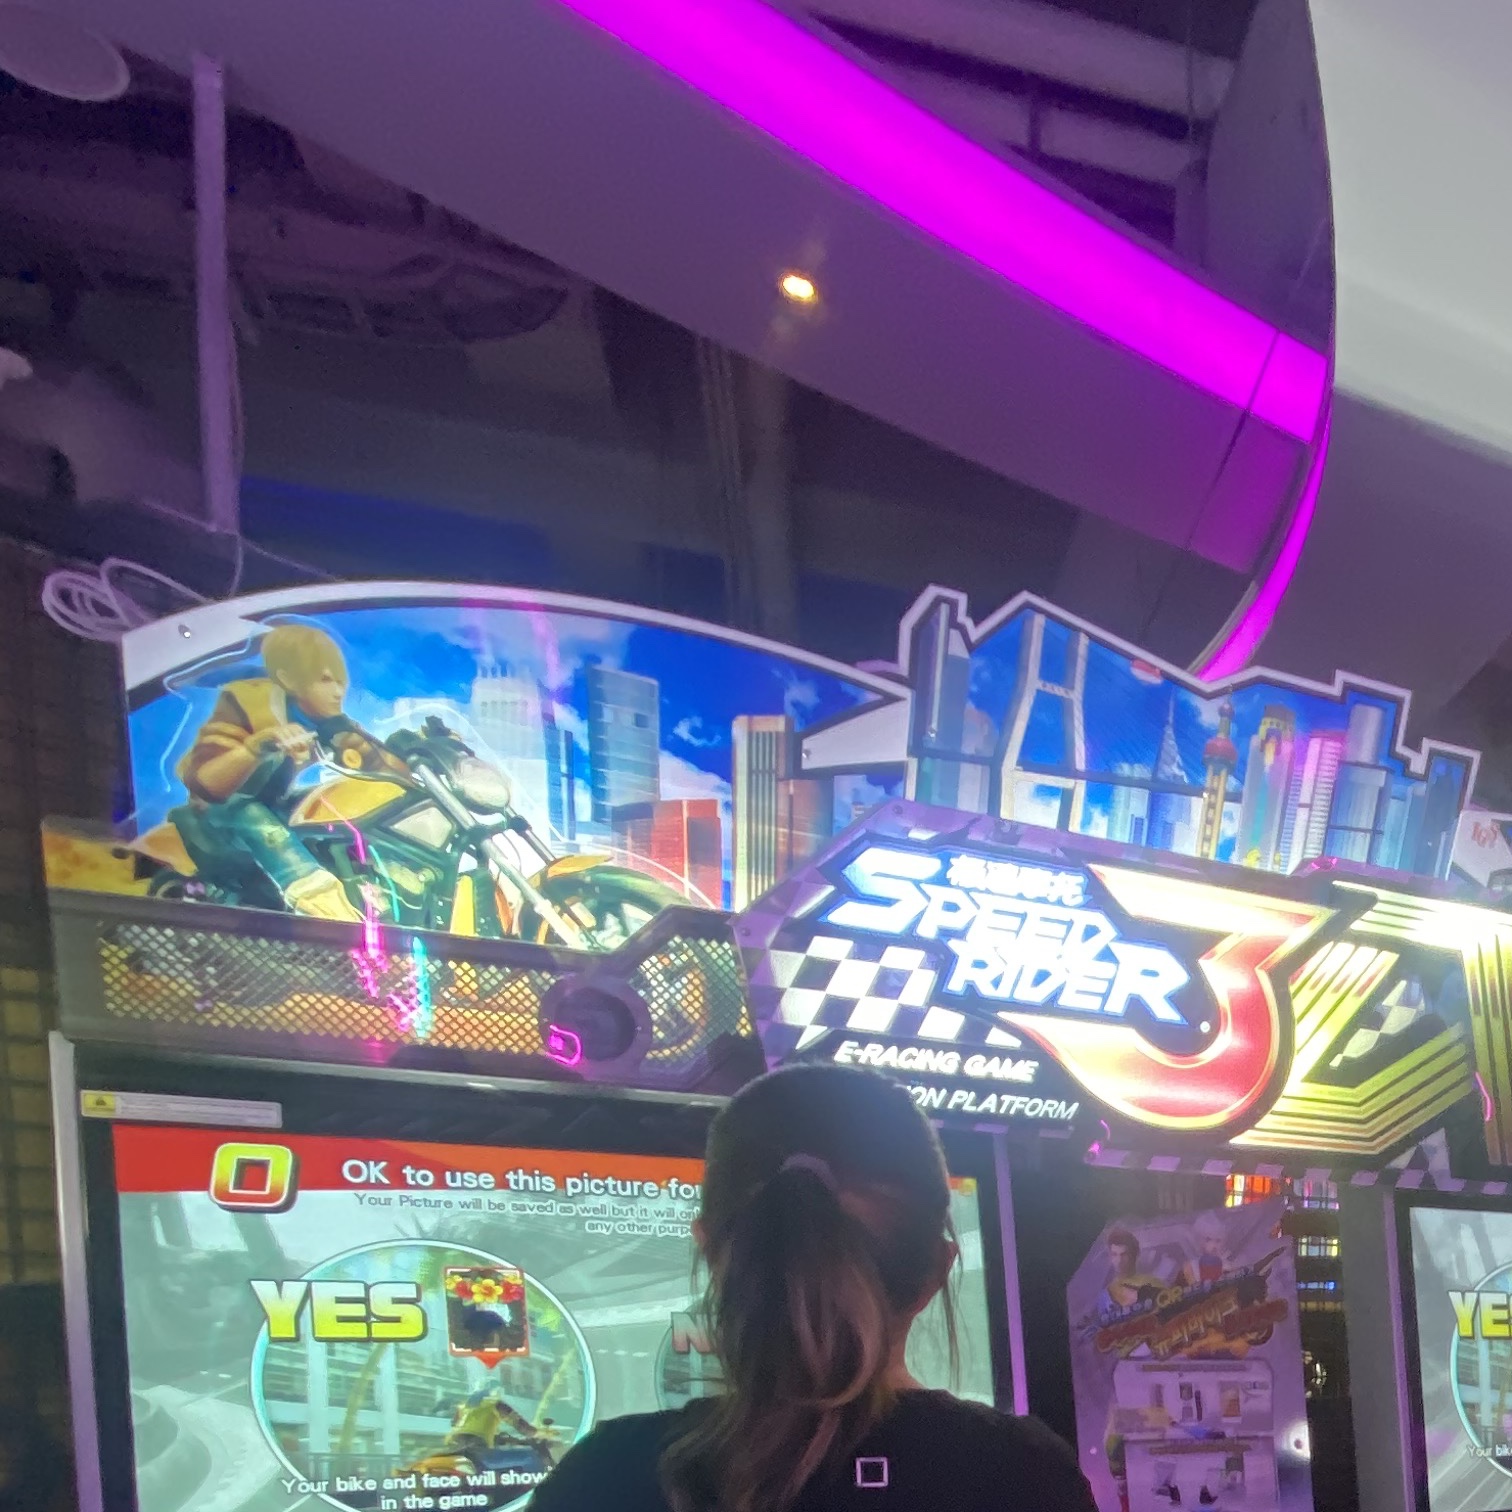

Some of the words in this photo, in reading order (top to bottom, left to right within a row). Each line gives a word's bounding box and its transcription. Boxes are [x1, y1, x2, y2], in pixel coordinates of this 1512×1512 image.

[824, 846, 1118, 958] SPEED
[946, 942, 1190, 1024] RIDER
[834, 1041, 957, 1077] E-RACING
[961, 1055, 1039, 1083] GAME
[948, 1089, 1079, 1121] PLATFORM
[342, 1159, 390, 1185] OK
[402, 1163, 435, 1188] to
[445, 1170, 495, 1190] use
[505, 1167, 556, 1193] this
[565, 1173, 660, 1199] picture
[354, 1192, 392, 1208] Your
[399, 1193, 453, 1210] Picture
[458, 1196, 483, 1210] will
[487, 1199, 506, 1212] be
[511, 1200, 554, 1215] saved
[559, 1203, 575, 1215] as
[579, 1203, 607, 1216] well
[611, 1204, 634, 1218] but
[639, 1205, 649, 1218] it
[653, 1206, 676, 1219] will
[586, 1219, 613, 1235] any
[617, 1218, 652, 1234] other
[658, 1222, 693, 1238] purp
[251, 1280, 428, 1343] YES
[670, 1311, 715, 1355] N
[1468, 1445, 1493, 1458] Your
[282, 1477, 329, 1496] Your
[336, 1475, 378, 1493] bike
[382, 1472, 417, 1490] and
[422, 1471, 461, 1489] face
[466, 1470, 497, 1488] will
[501, 1468, 549, 1486] show
[381, 1493, 398, 1511] in
[403, 1492, 434, 1510] the
[438, 1493, 489, 1512] game
